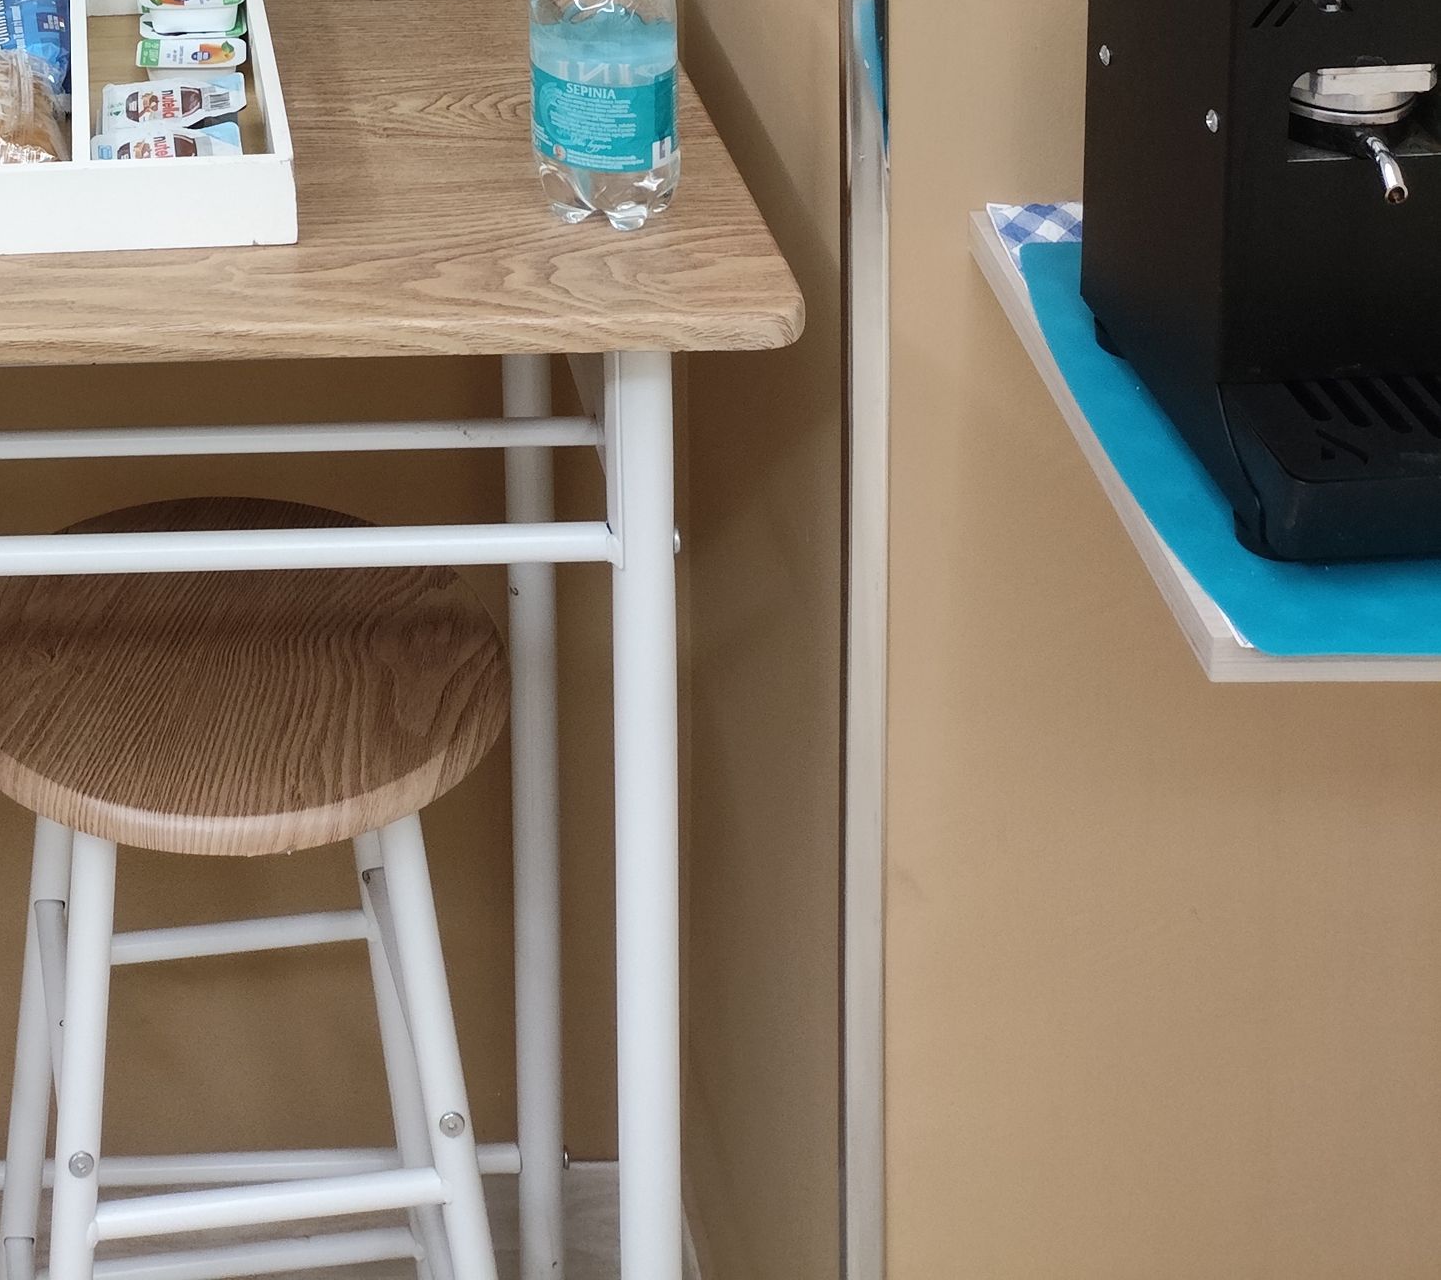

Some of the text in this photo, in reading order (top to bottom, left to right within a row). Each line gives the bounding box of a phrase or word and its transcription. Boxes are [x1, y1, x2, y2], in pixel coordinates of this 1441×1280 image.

[565, 82, 616, 100] SEPINIA
[161, 89, 180, 120] nutella
[153, 136, 173, 158] nutel
